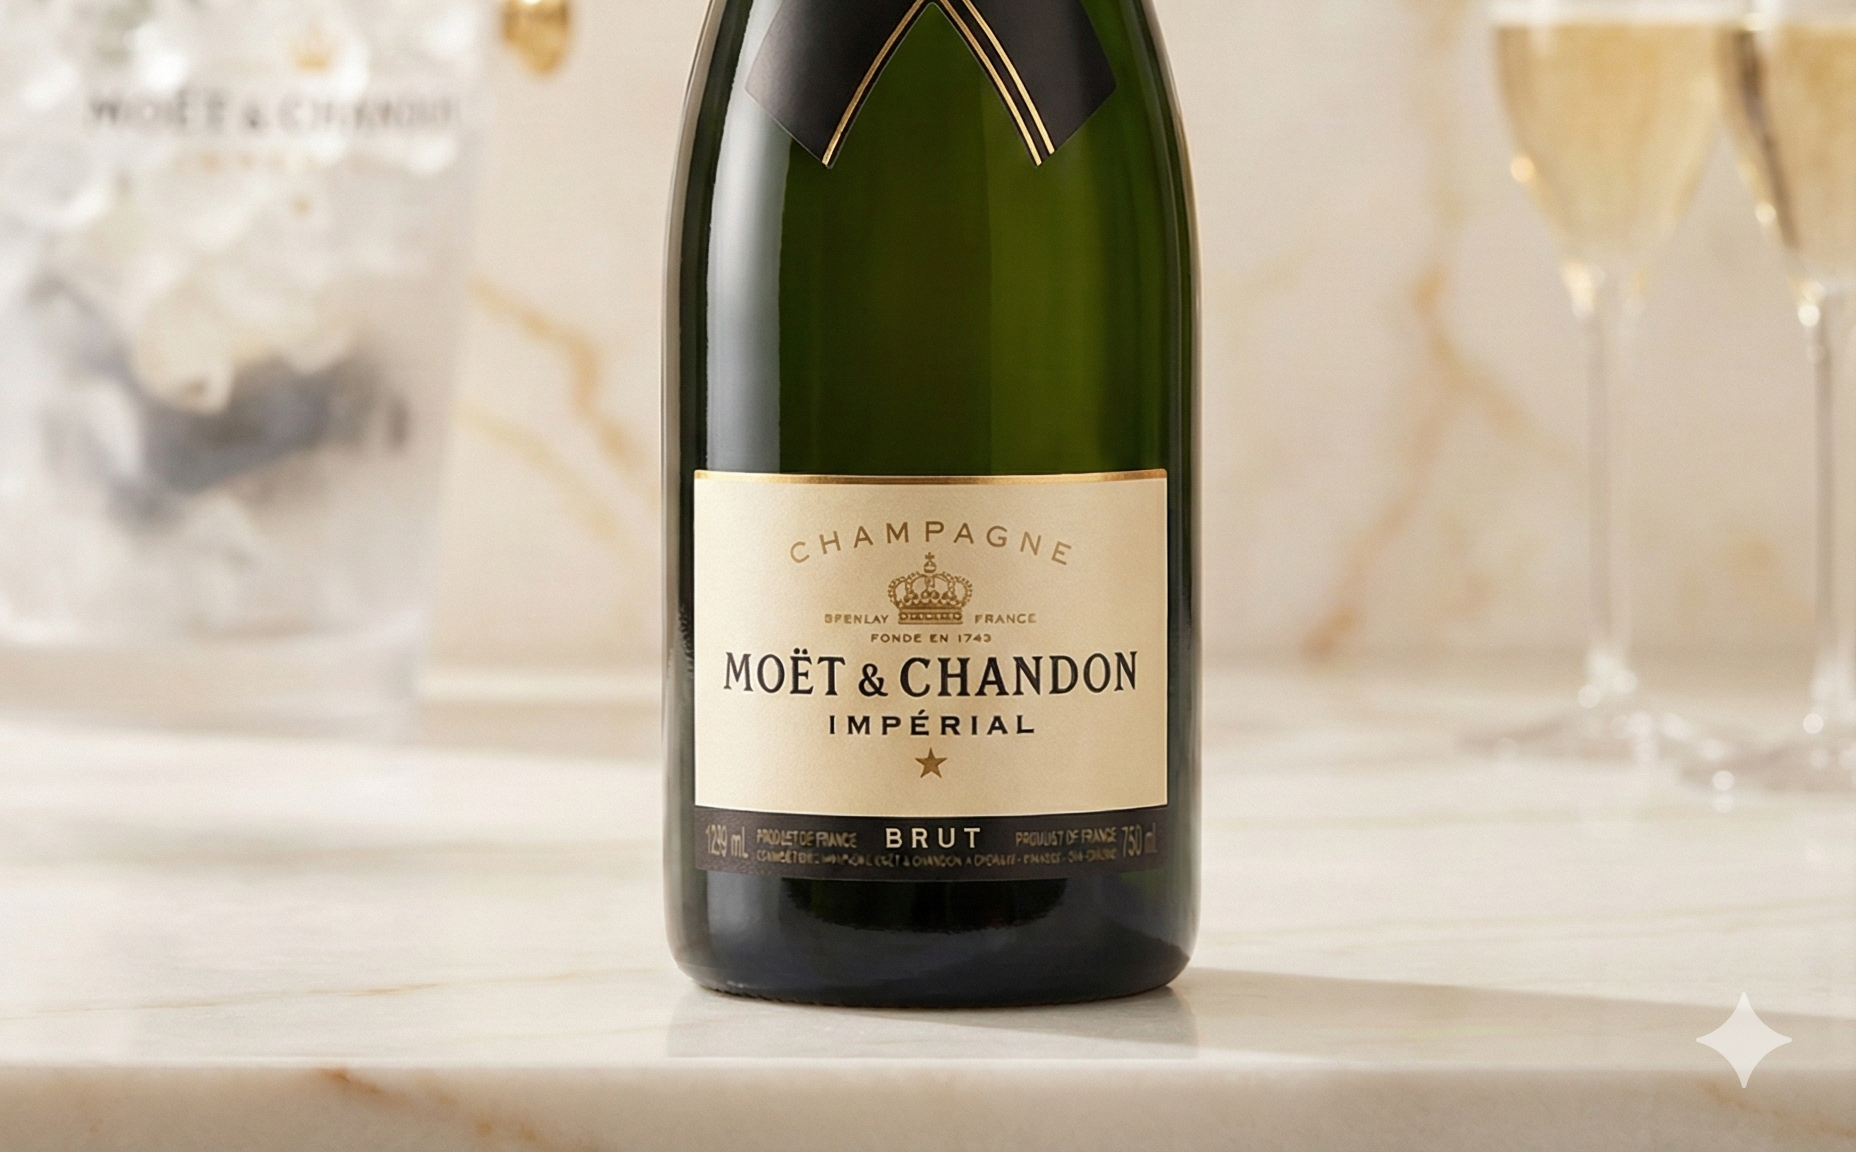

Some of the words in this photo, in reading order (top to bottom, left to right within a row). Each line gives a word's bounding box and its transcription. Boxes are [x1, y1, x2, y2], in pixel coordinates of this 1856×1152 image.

[789, 521, 1073, 566] CHAMPAGNE
[974, 613, 1037, 624] FRANCE
[870, 633, 922, 643] FONDE
[930, 633, 949, 643] EN
[957, 633, 992, 643] 1743
[723, 648, 846, 697] MOËT
[858, 662, 889, 697] &
[900, 651, 1138, 699] CHANDON
[829, 709, 1035, 737] IMPÉRIAL
[885, 827, 981, 849] BRUT
[1121, 823, 1143, 858] 750
